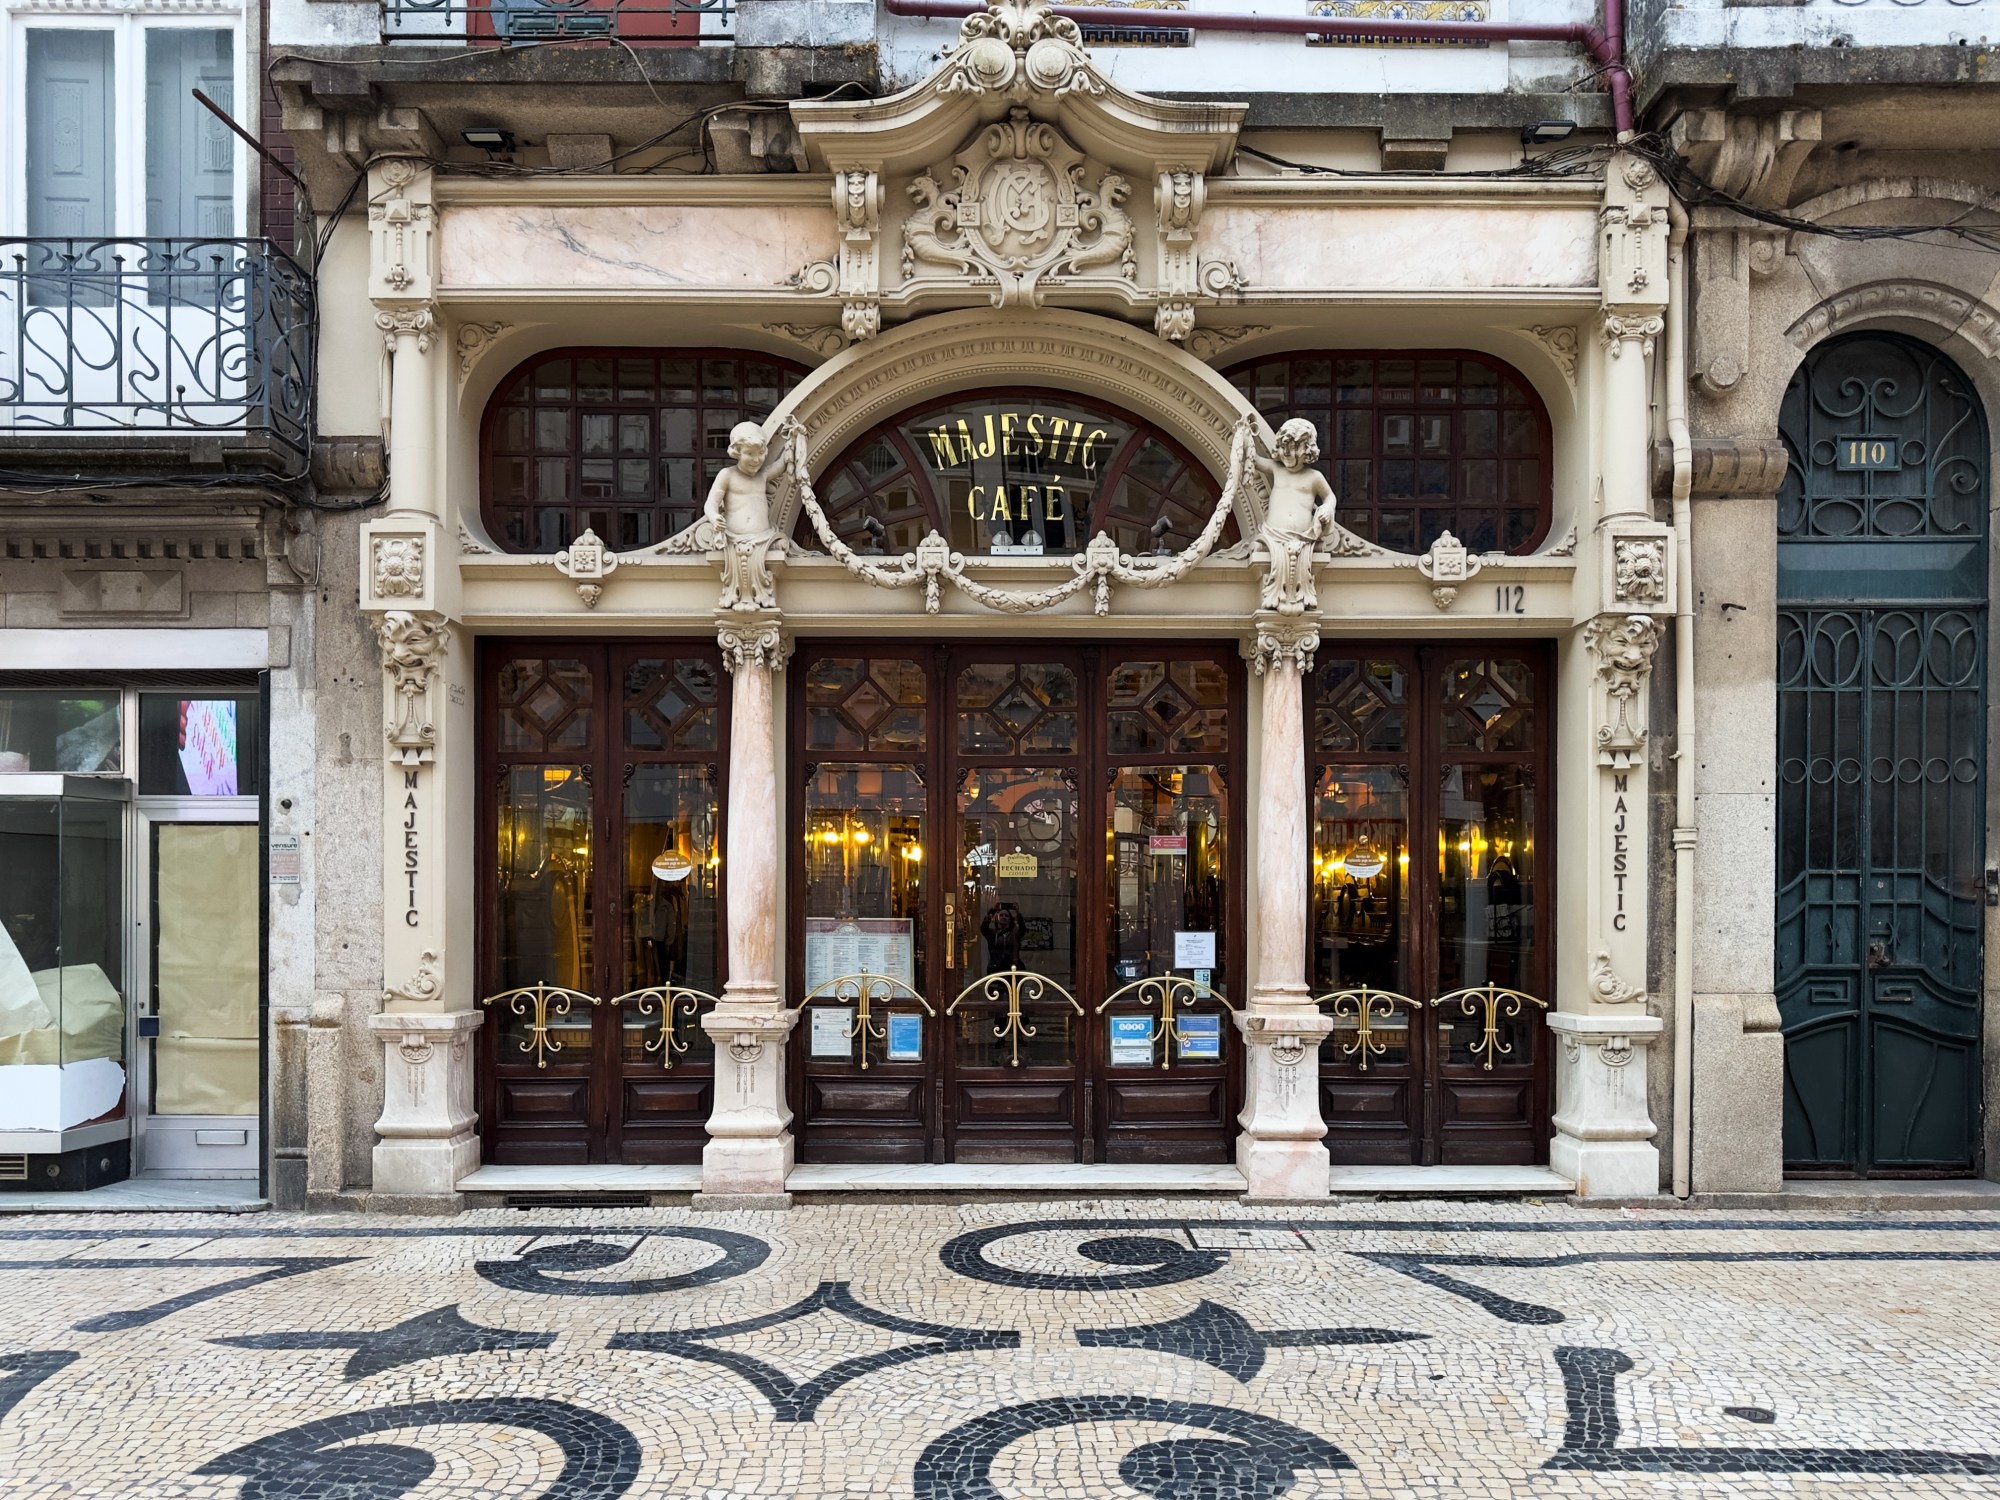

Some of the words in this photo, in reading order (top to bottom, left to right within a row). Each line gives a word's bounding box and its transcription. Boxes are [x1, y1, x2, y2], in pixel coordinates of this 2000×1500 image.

[928, 413, 1107, 470] MAJESTIC
[1850, 442, 1885, 463] 110
[968, 475, 1065, 520] CAFÉ
[1496, 585, 1525, 614] 112
[404, 771, 418, 927] MAJESTIC
[1613, 775, 1628, 931] MAJESTIC
